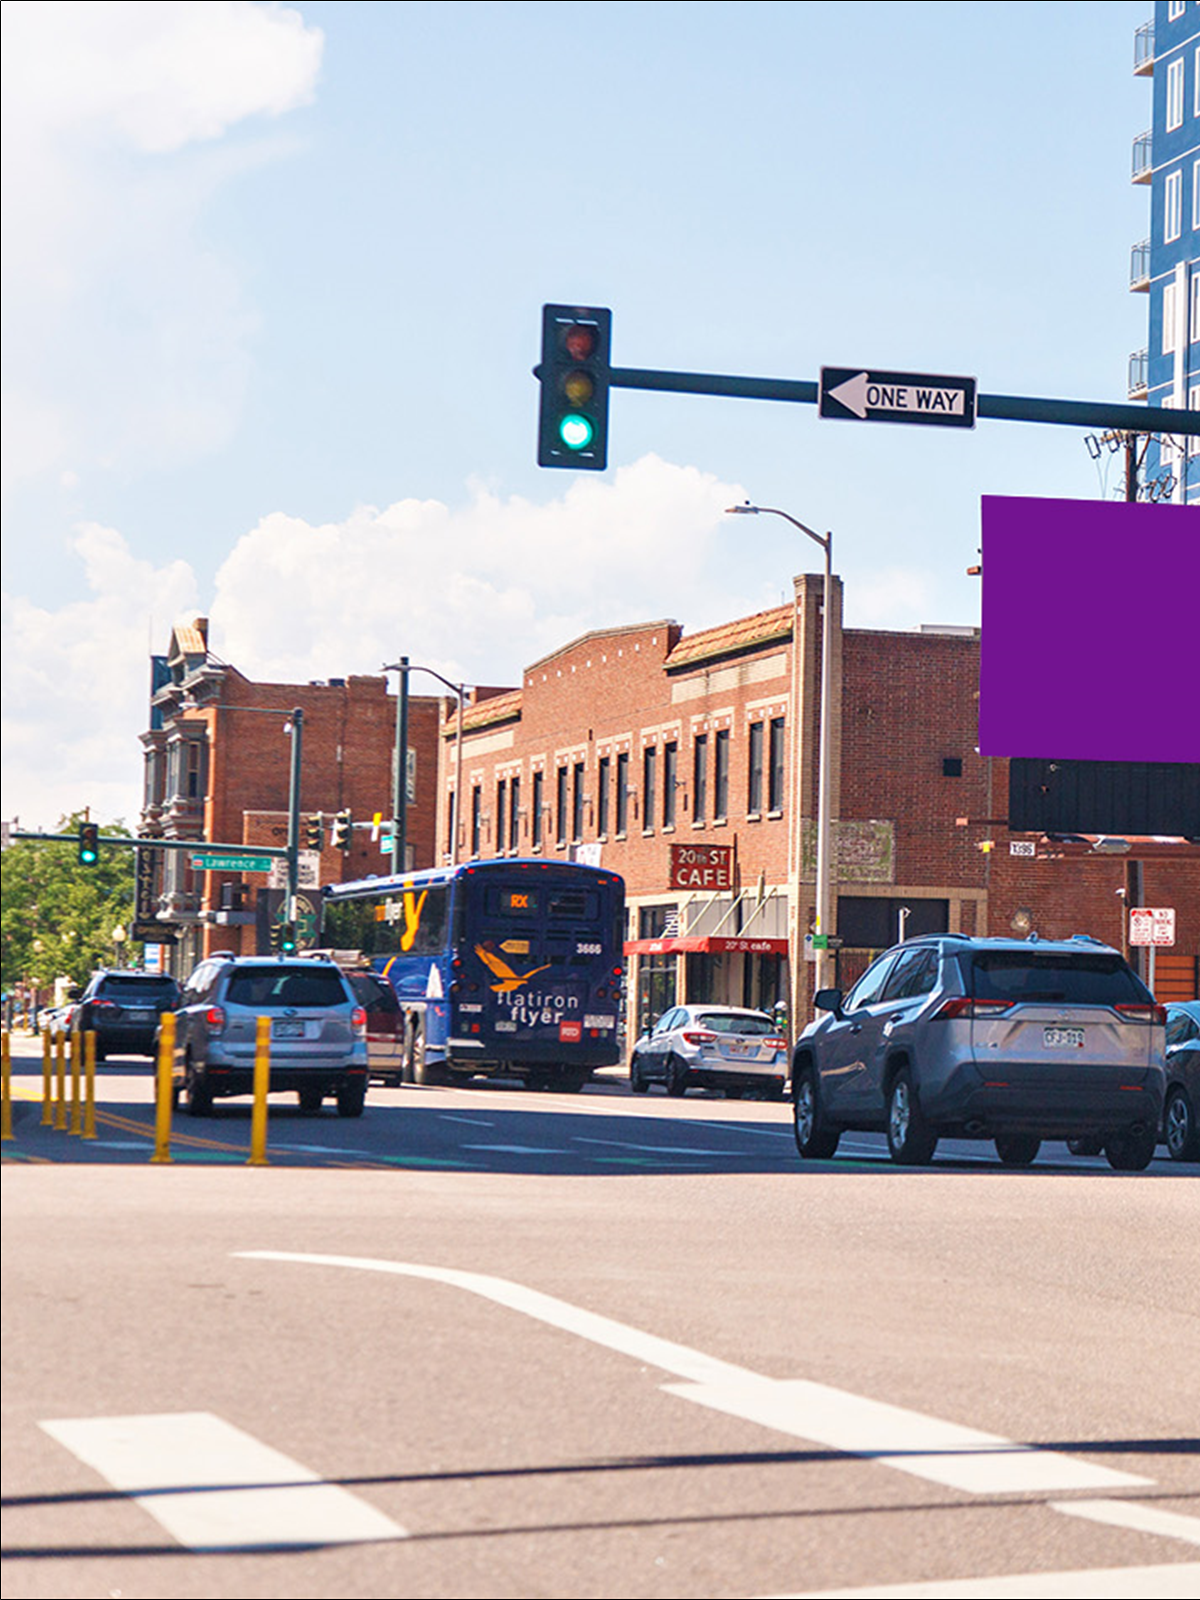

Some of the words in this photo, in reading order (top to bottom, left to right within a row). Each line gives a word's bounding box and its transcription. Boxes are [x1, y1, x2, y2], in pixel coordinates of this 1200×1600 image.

[866, 386, 908, 408] ONE
[916, 390, 958, 411] WAY
[205, 858, 256, 868] Lawrence
[677, 868, 727, 886] CAFE
[510, 894, 528, 908] RX
[750, 941, 772, 951] cafe
[498, 990, 579, 1008] flatiron
[511, 1006, 564, 1027] flyer
